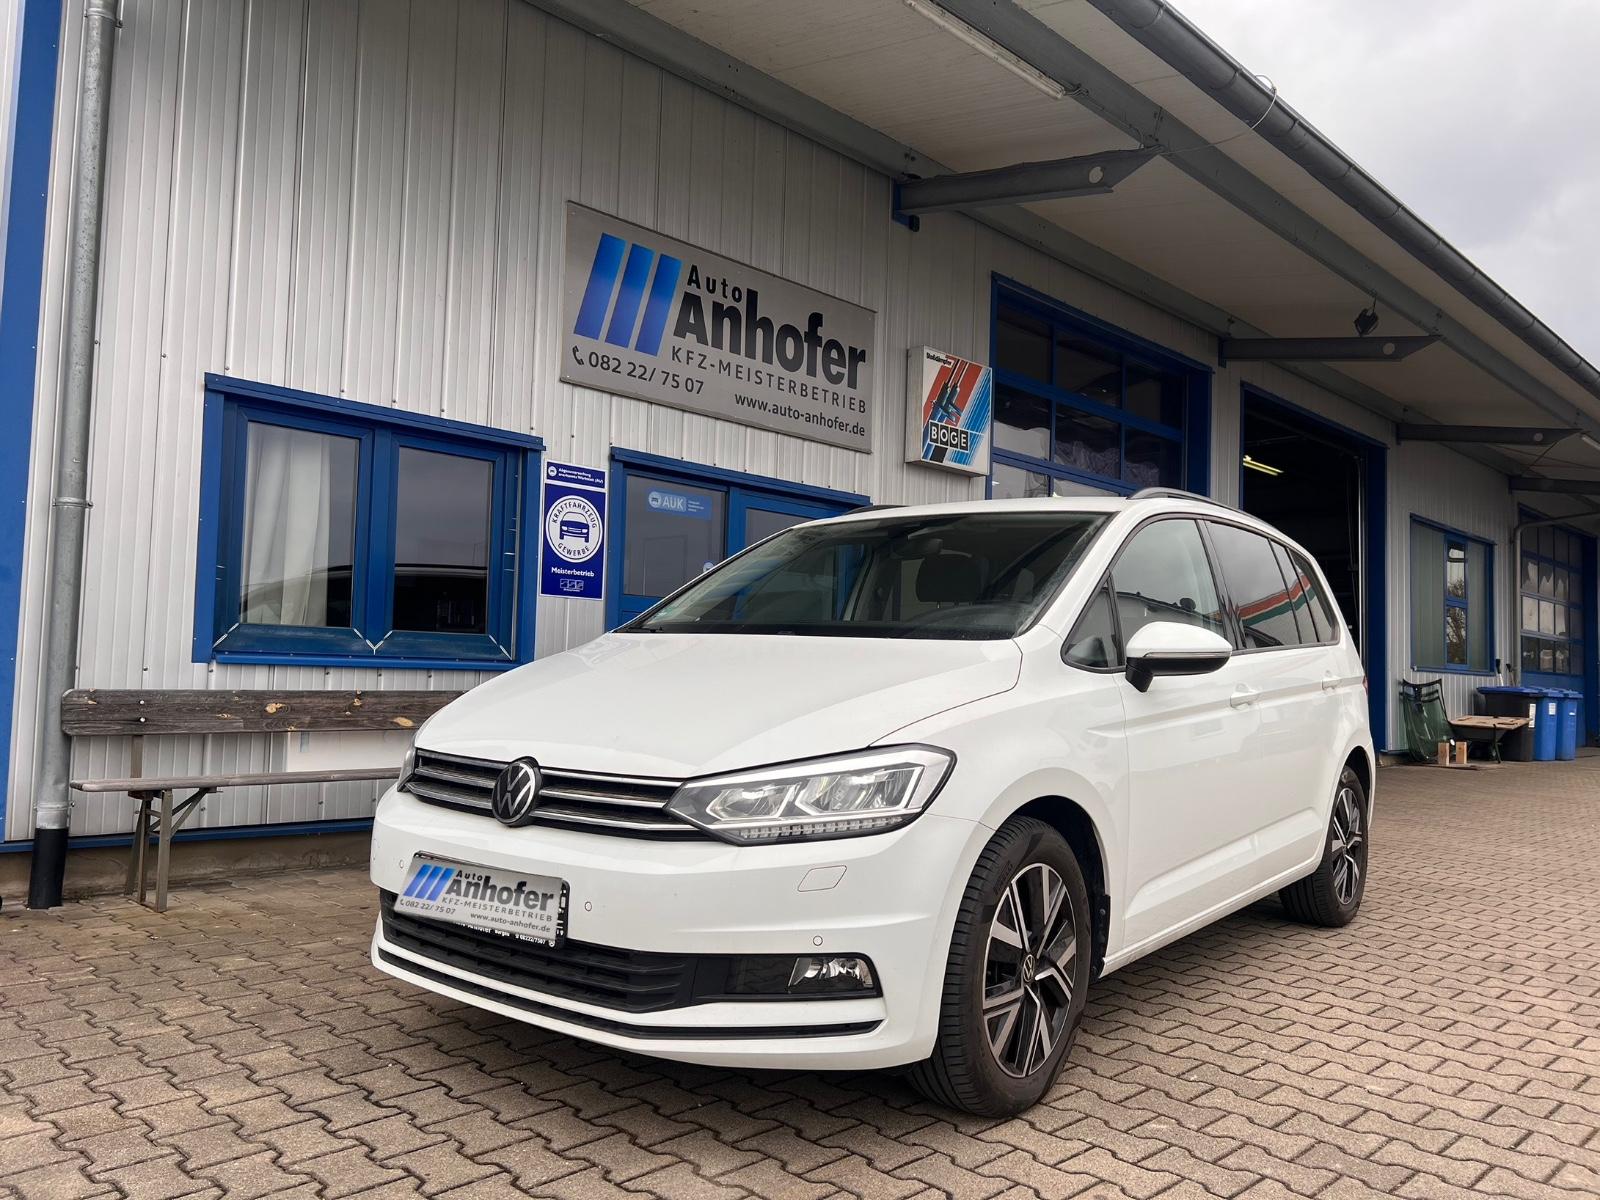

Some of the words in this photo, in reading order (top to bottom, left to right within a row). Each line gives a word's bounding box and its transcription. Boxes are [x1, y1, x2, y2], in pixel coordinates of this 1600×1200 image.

[687, 264, 743, 303] Auto
[673, 287, 866, 390] Anhofer
[588, 351, 622, 374] 082
[626, 361, 656, 382] 22/
[661, 370, 680, 389] 75
[685, 377, 704, 395] 07
[671, 345, 867, 414] KFZ-MEISTERBETRIEB
[734, 393, 866, 437] www.auto-anhofer.de
[931, 428, 967, 448] BOGE
[551, 501, 598, 529] KRAFTFAHRZEUG
[662, 495, 684, 511] AUK
[551, 566, 595, 577] Meisterbetrieb
[456, 869, 483, 883] Auto
[445, 875, 555, 912] Anhofer
[441, 896, 553, 923] KFZ-MEISTERBETRIEB
[470, 912, 551, 933] www.auto-anhofer.de
